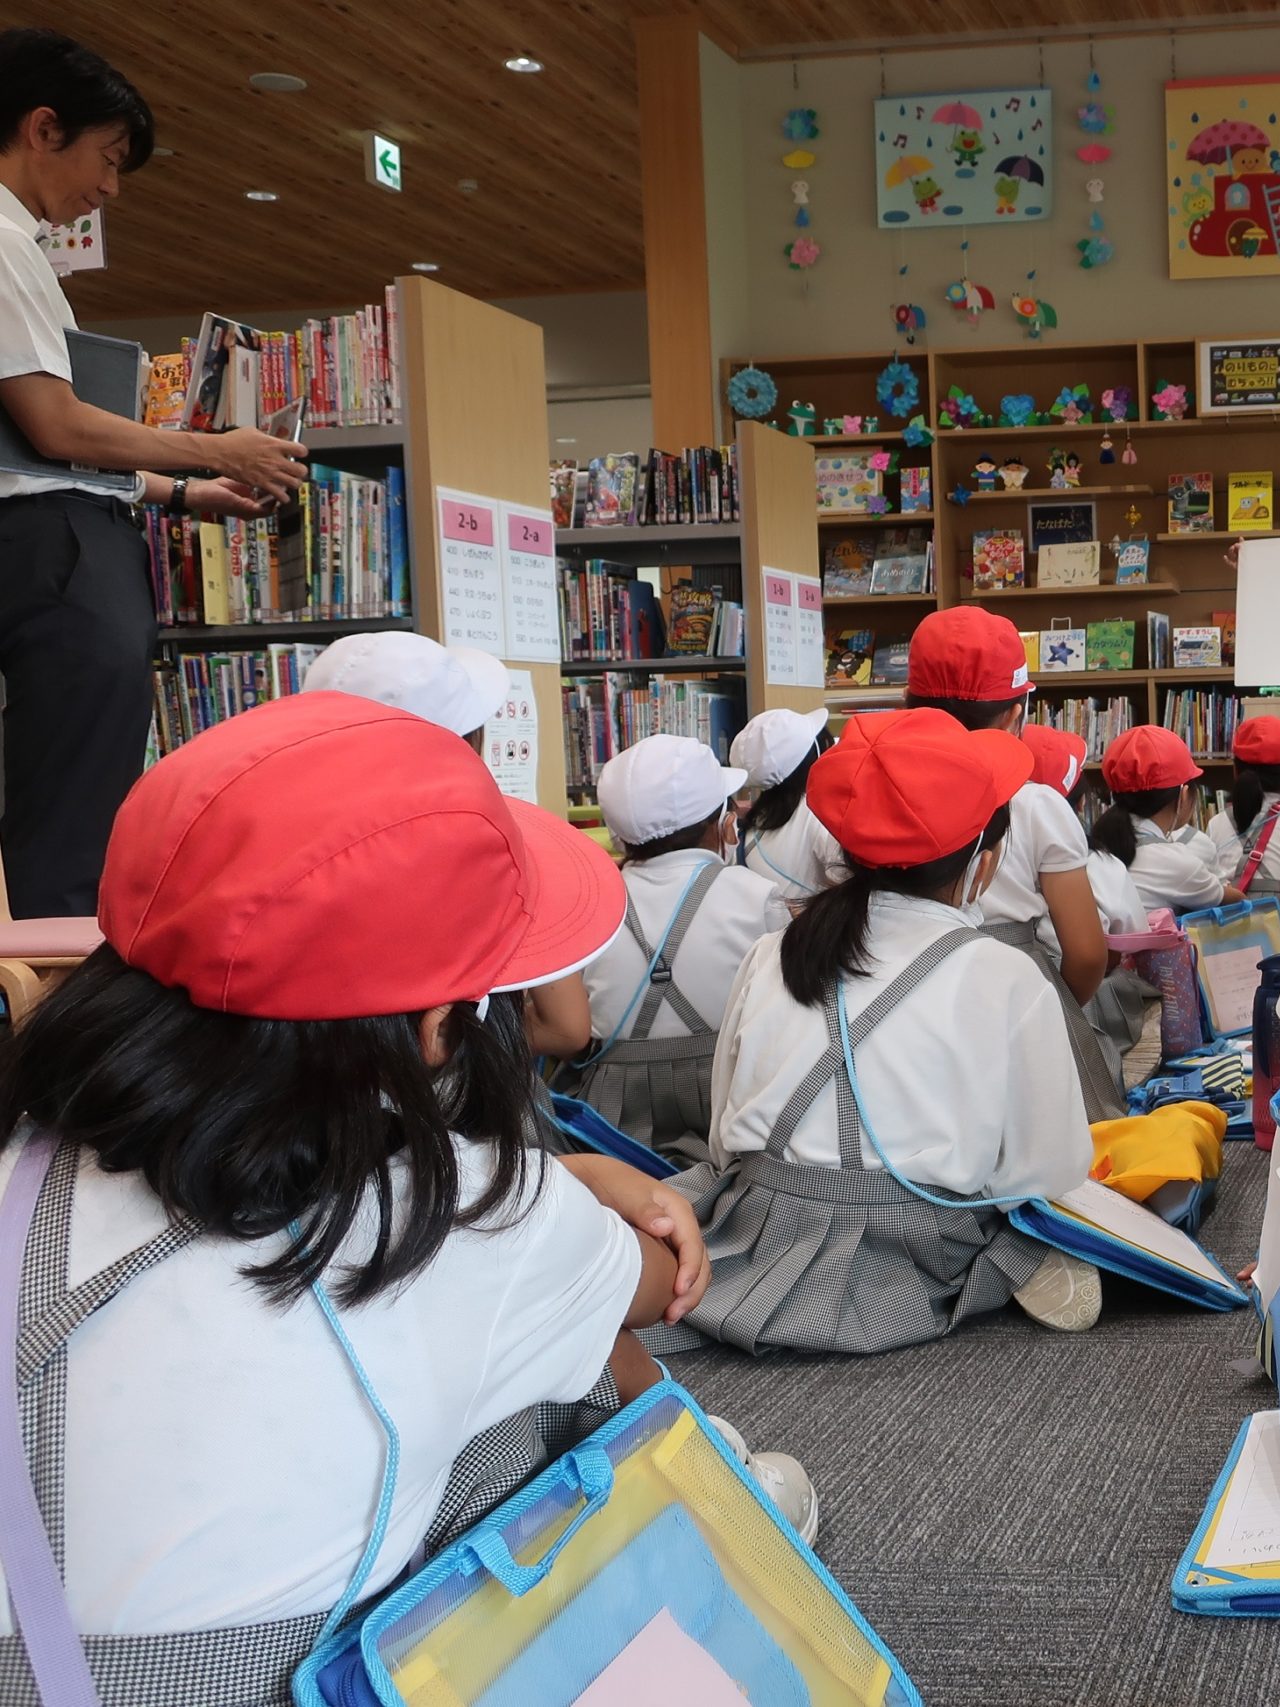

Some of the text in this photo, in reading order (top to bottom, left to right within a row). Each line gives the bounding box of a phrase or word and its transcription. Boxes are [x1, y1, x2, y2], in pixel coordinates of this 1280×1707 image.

[1225, 360, 1278, 372] のりものに
[816, 473, 865, 484] めのきせつ
[458, 512, 478, 531] 2-b
[522, 525, 540, 543] 2-a
